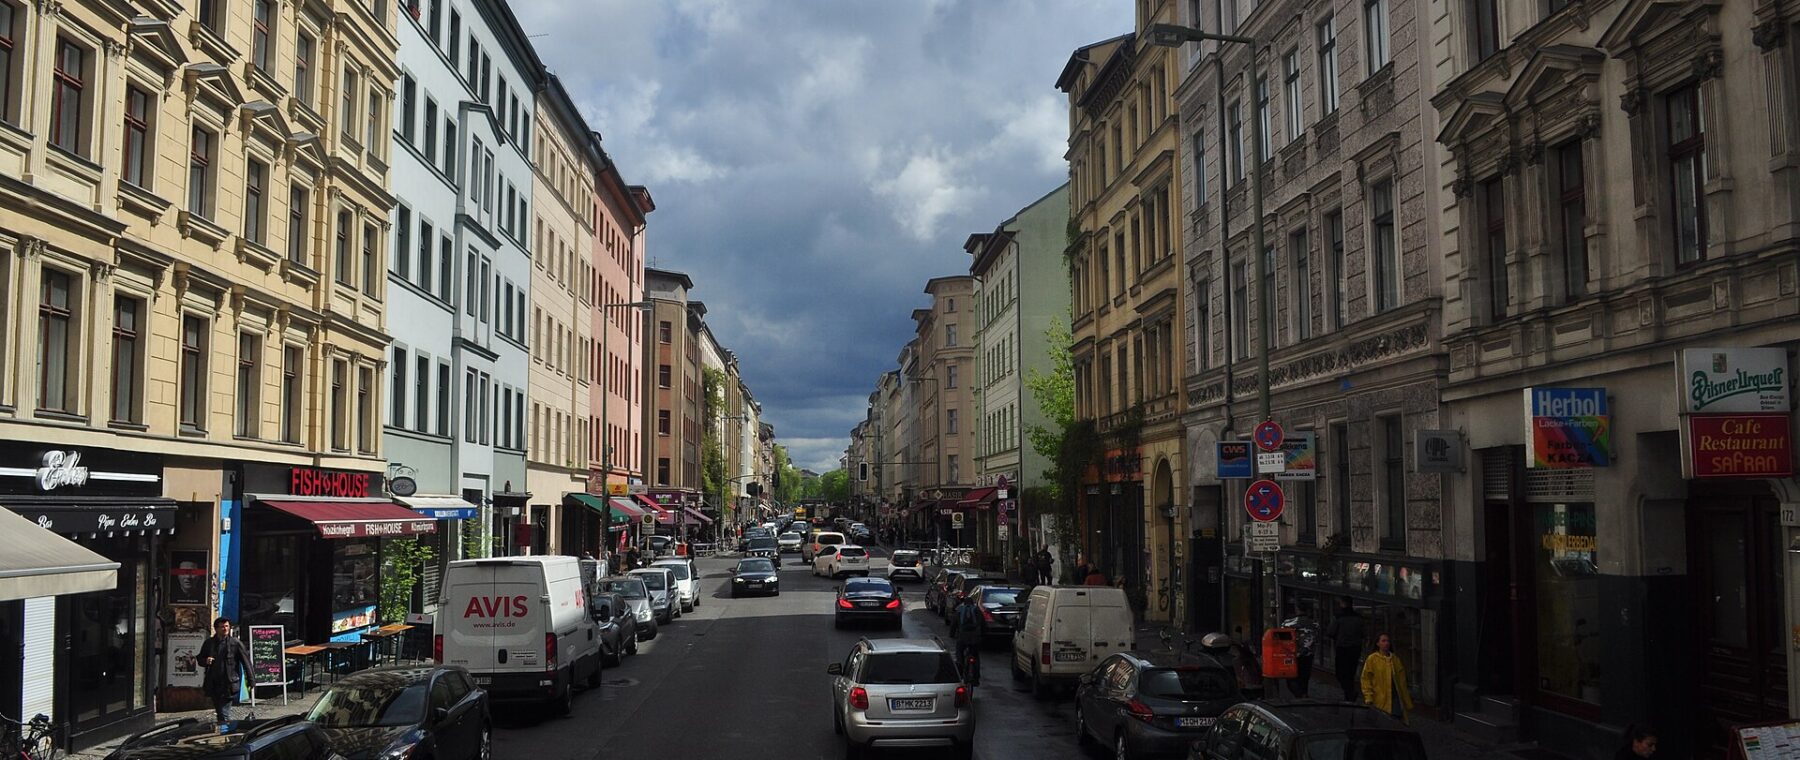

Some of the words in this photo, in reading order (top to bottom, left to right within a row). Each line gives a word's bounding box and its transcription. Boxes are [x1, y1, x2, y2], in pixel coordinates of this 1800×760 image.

[1691, 369, 1738, 411] Pilsner
[1736, 366, 1784, 393] Urquell
[1537, 390, 1600, 417] Herbol
[1721, 418, 1761, 435] Cafe
[1222, 445, 1246, 454] CWS
[1699, 435, 1784, 451] Restaurant
[1547, 453, 1594, 464] KACZA
[291, 467, 323, 496] FISH
[331, 474, 369, 498] HOUSE
[1782, 509, 1794, 522] 172
[365, 524, 380, 536] FISH
[383, 522, 402, 534] HOUSE
[463, 595, 529, 619] AVIS
[473, 620, 516, 628] www.avis.de
